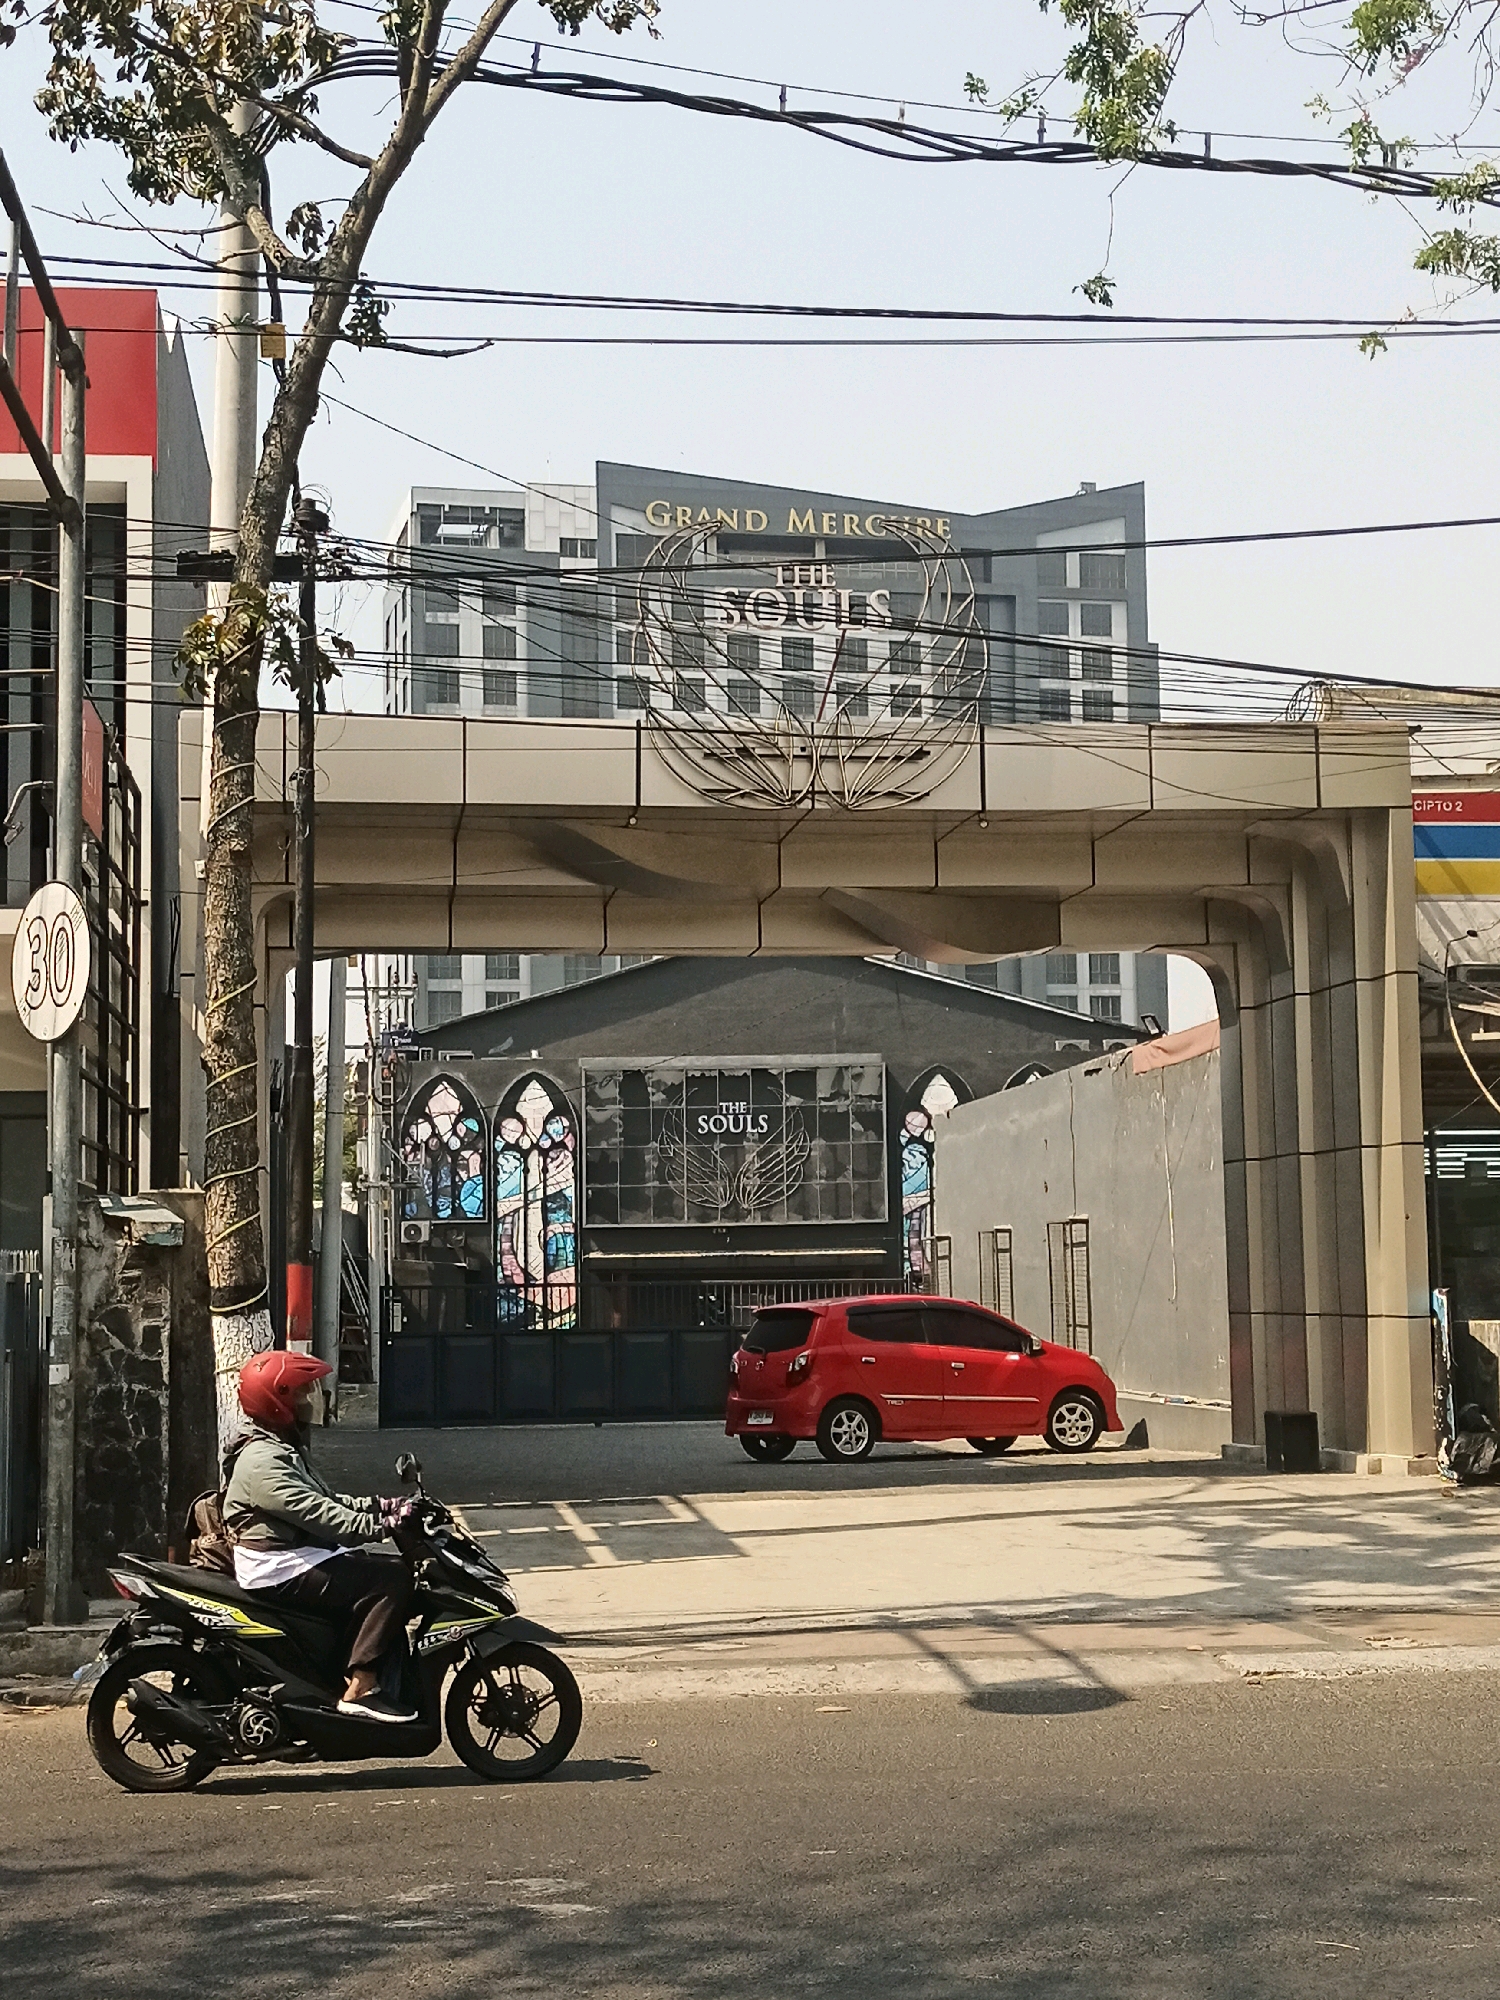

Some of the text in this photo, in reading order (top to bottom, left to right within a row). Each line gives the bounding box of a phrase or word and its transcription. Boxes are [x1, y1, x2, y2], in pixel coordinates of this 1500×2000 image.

[645, 500, 952, 539] GRAND MERCURE
[775, 563, 837, 588] THE
[715, 587, 892, 632] SOULS
[1413, 800, 1463, 812] CIPTO 2
[25, 911, 75, 1010] 30
[719, 1101, 747, 1114] THE
[697, 1114, 769, 1134] SOULS
